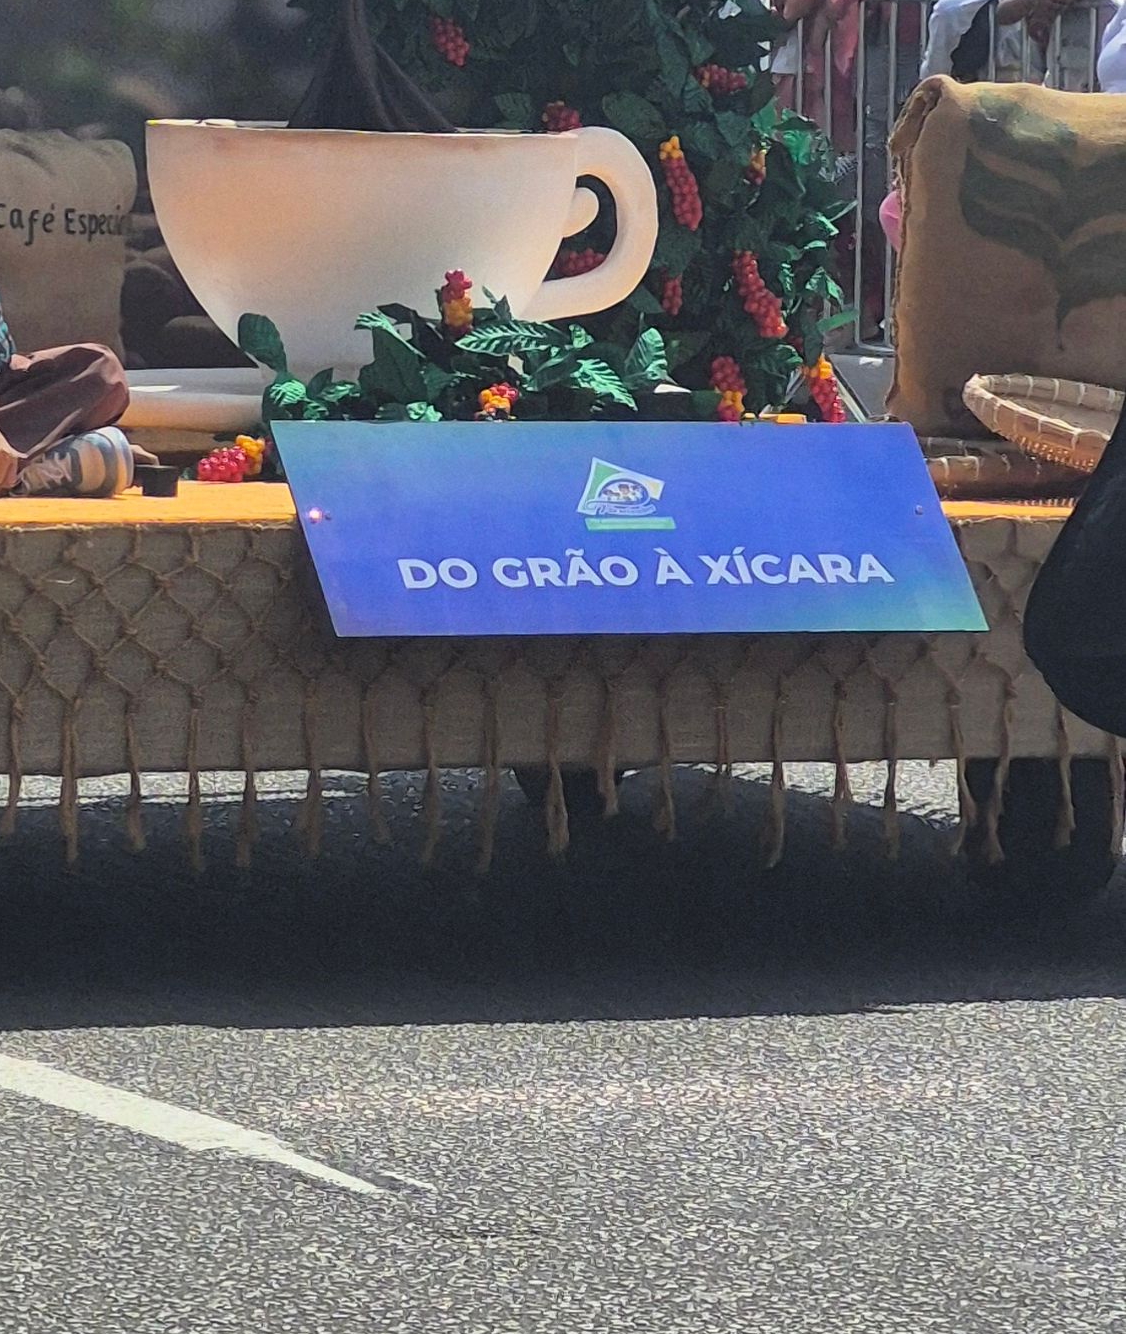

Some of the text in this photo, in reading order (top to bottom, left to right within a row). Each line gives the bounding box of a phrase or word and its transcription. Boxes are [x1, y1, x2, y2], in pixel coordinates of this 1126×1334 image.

[63, 204, 127, 242] Especi
[398, 546, 895, 589] DO GRÃO À XÍCARA
